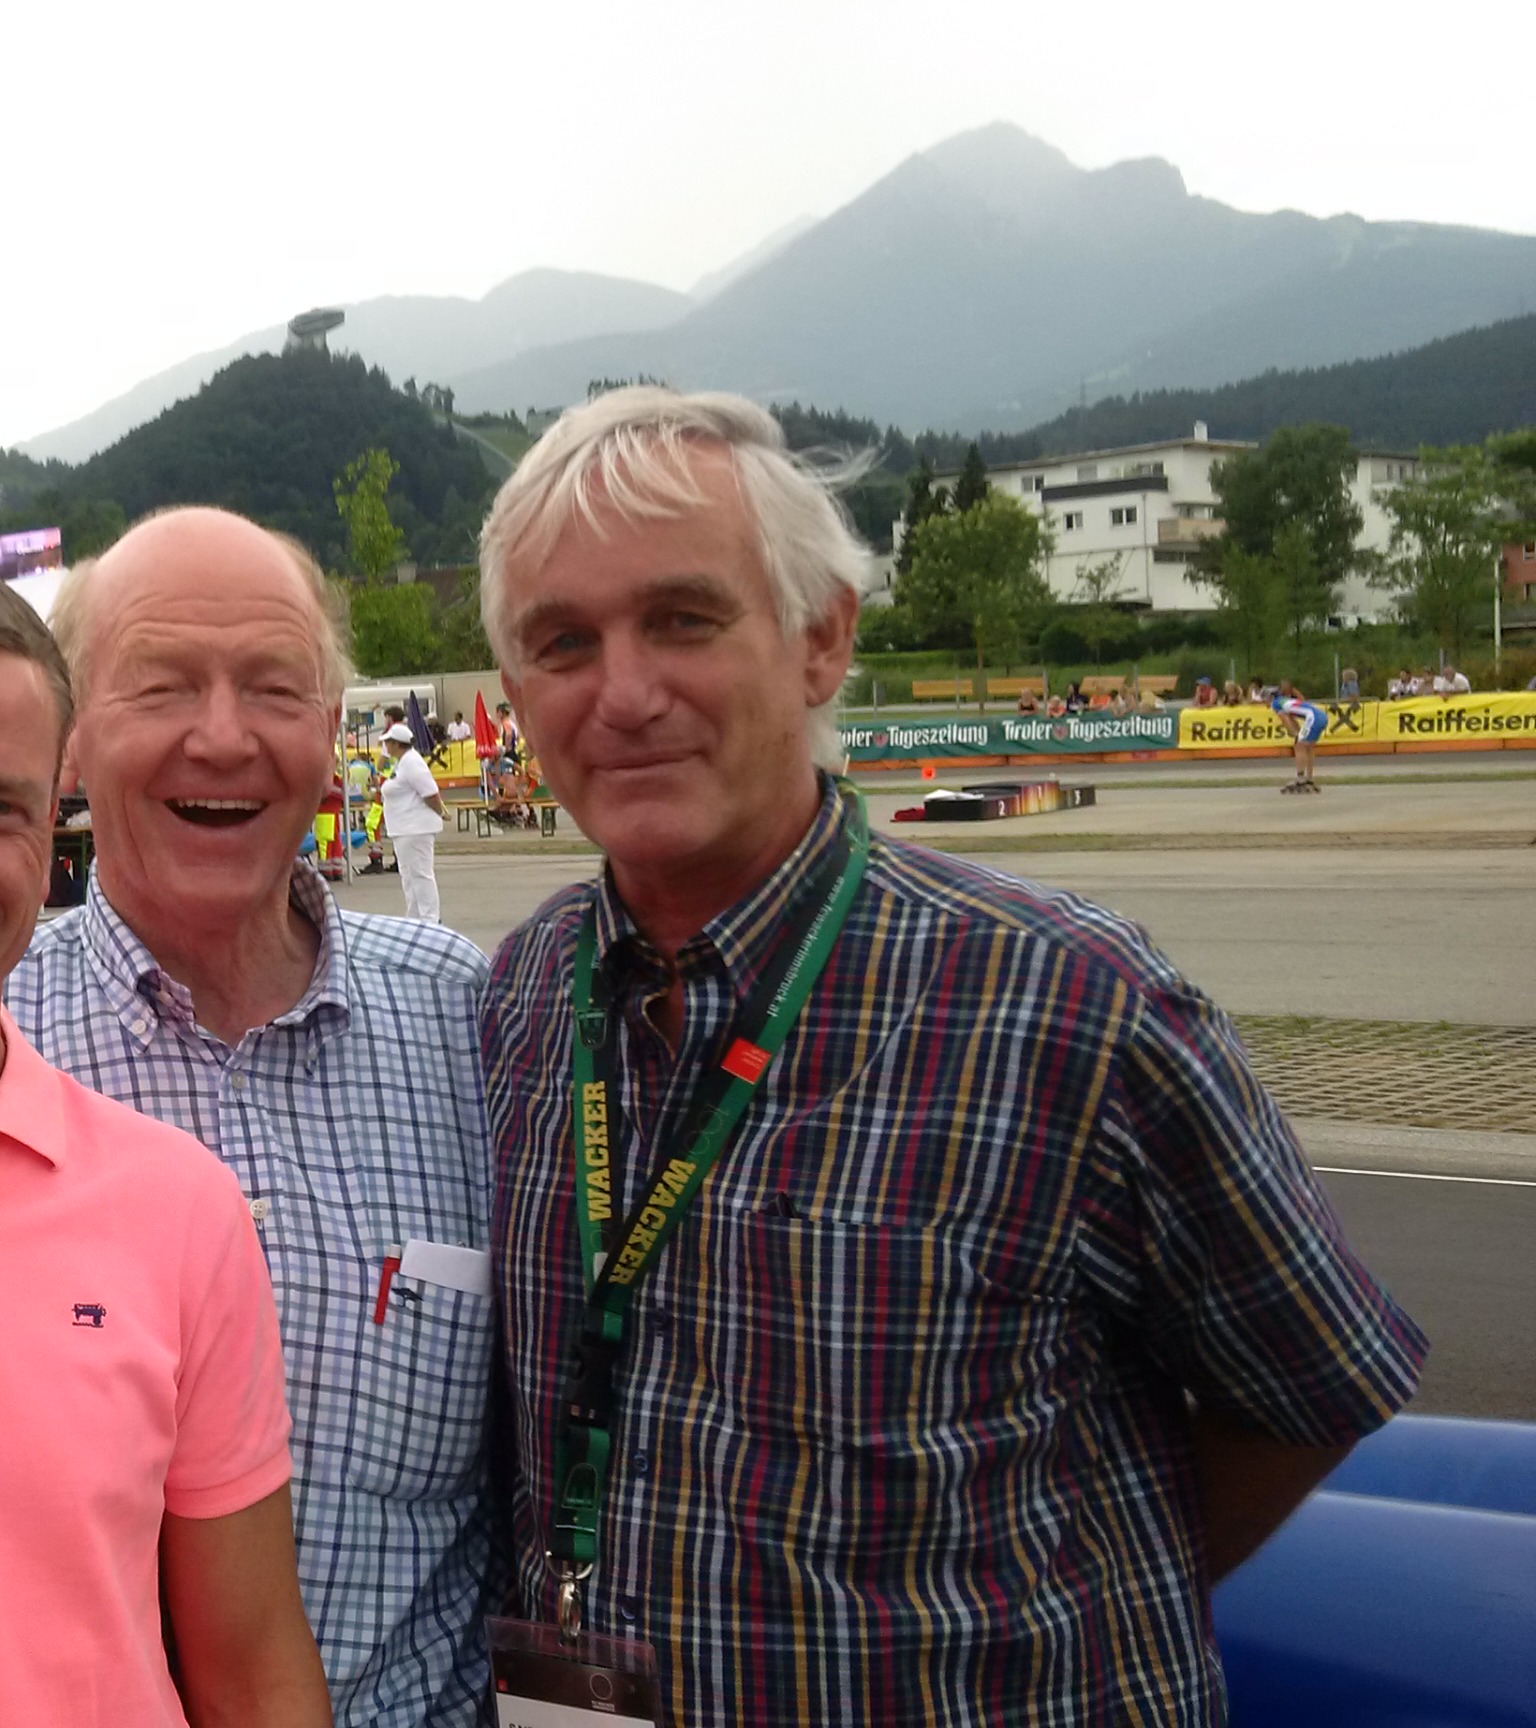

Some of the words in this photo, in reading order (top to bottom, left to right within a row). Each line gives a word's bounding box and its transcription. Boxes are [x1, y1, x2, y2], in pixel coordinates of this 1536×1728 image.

[885, 724, 988, 749] Tageszeitung
[1002, 719, 1053, 741] Tiroler
[1066, 714, 1173, 743] Tageszeitung
[1191, 717, 1293, 741] Raiffeis
[998, 800, 1006, 816] 2
[582, 1080, 613, 1222] WACKER
[608, 1158, 696, 1285] WACKER
